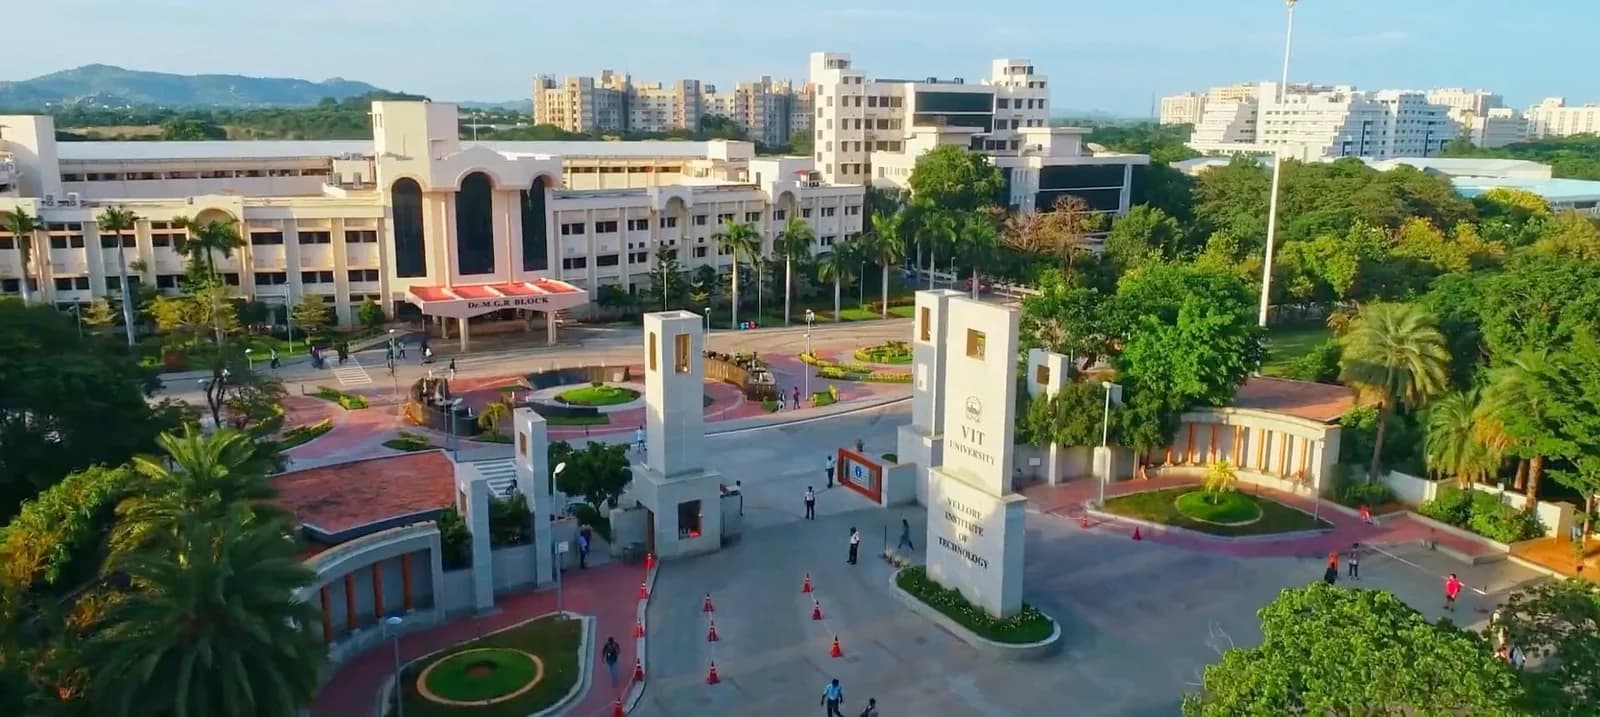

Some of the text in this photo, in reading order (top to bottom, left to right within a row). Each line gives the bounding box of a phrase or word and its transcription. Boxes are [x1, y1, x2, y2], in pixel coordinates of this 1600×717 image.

[514, 297, 549, 305] BLOCK
[961, 425, 985, 446] VIT
[949, 440, 995, 465] UNIVERSITY
[947, 497, 983, 520] VELLORE
[945, 512, 984, 536] INSTITUTE
[958, 534, 969, 544] OF
[938, 536, 989, 569] TECHNOLOGY
